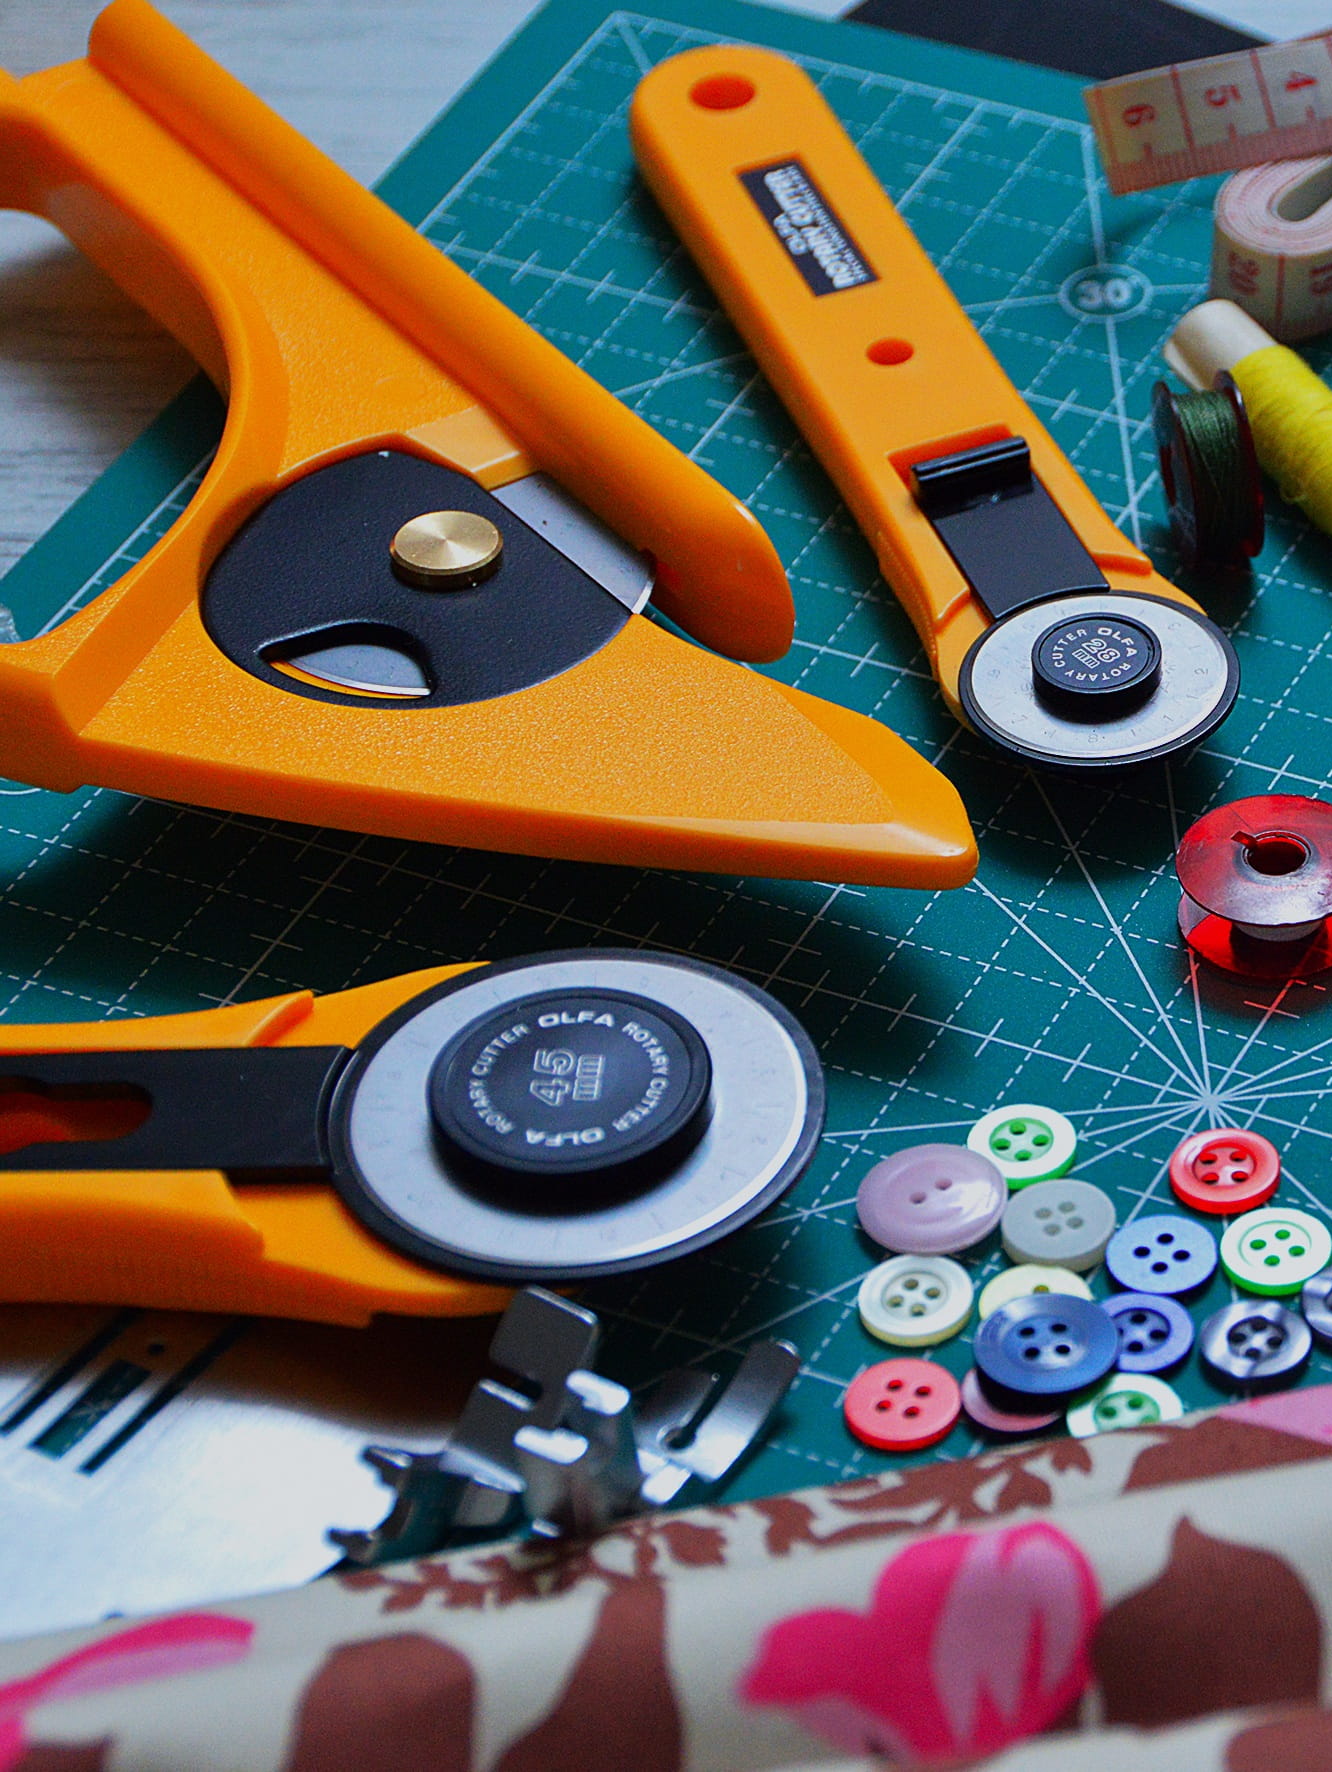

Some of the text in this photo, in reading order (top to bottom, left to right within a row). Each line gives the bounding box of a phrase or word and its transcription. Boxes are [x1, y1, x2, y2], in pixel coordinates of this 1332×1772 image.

[1204, 84, 1241, 107] 5
[1285, 71, 1319, 92] 4
[1122, 104, 1156, 128] 6
[764, 168, 856, 289] ROTARY CUTTER
[1052, 627, 1138, 682] OLFA ROTARY CUTTER
[1071, 648, 1100, 669] mm
[1082, 638, 1121, 662] 28
[468, 1010, 671, 1147] OLFA ROTARY CUTTER OLFA ROTARY CUTTER
[529, 1048, 577, 1106] 45
[573, 1054, 606, 1101] mm
